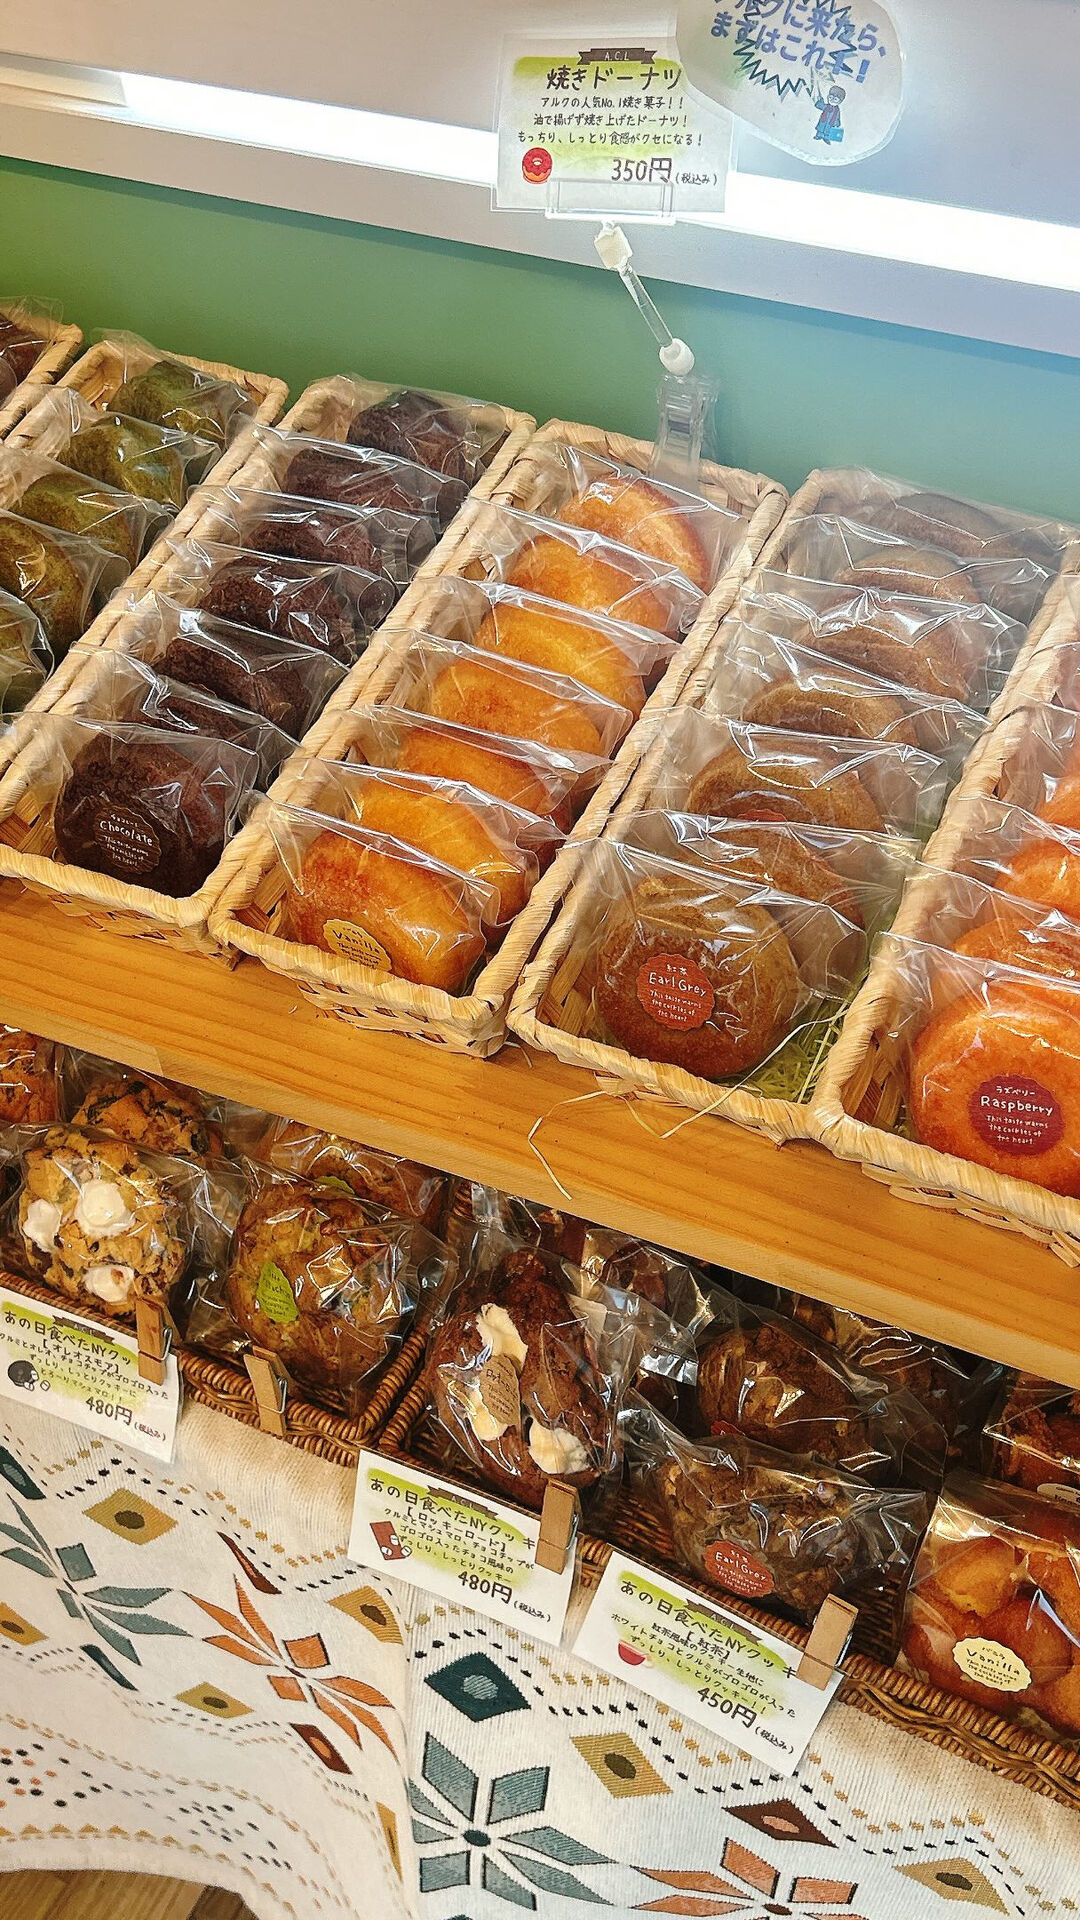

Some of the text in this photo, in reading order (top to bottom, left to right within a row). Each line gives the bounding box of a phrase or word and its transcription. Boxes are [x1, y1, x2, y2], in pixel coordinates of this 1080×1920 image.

[546, 65, 682, 90] 焼きドーナツ
[533, 114, 687, 127] 油で揚げず焼き上げたドーナツ！
[518, 131, 702, 146] もっちり、しっとり食感がクセになる！
[611, 158, 672, 183] 350円
[99, 820, 153, 847] Chocolate
[648, 972, 706, 997] Earl Grey
[980, 1095, 1053, 1116] Raspberry
[996, 1086, 1035, 1097] ラズベリー
[4, 1310, 131, 1365] あの日食べたNYクッ
[85, 1396, 133, 1426] 480円
[370, 1477, 536, 1549] あの日食べたNYクッキ
[407, 1507, 507, 1552] 【ロッキーロード】
[400, 1524, 514, 1575] ゴロゴロ入ったチョコ風味の
[715, 1551, 739, 1568] Earl
[458, 1571, 513, 1605] 480円
[620, 1581, 797, 1678] あの日食べたNYクッキ
[651, 1622, 764, 1687] 紅茶風味のクッキー生地に
[686, 1630, 730, 1660] 【紅茶】
[611, 1612, 796, 1719] ホワイトチョコとクルミがゴロゴロが入った
[966, 1648, 1020, 1675] Vanilla
[697, 1687, 757, 1728] 450円
